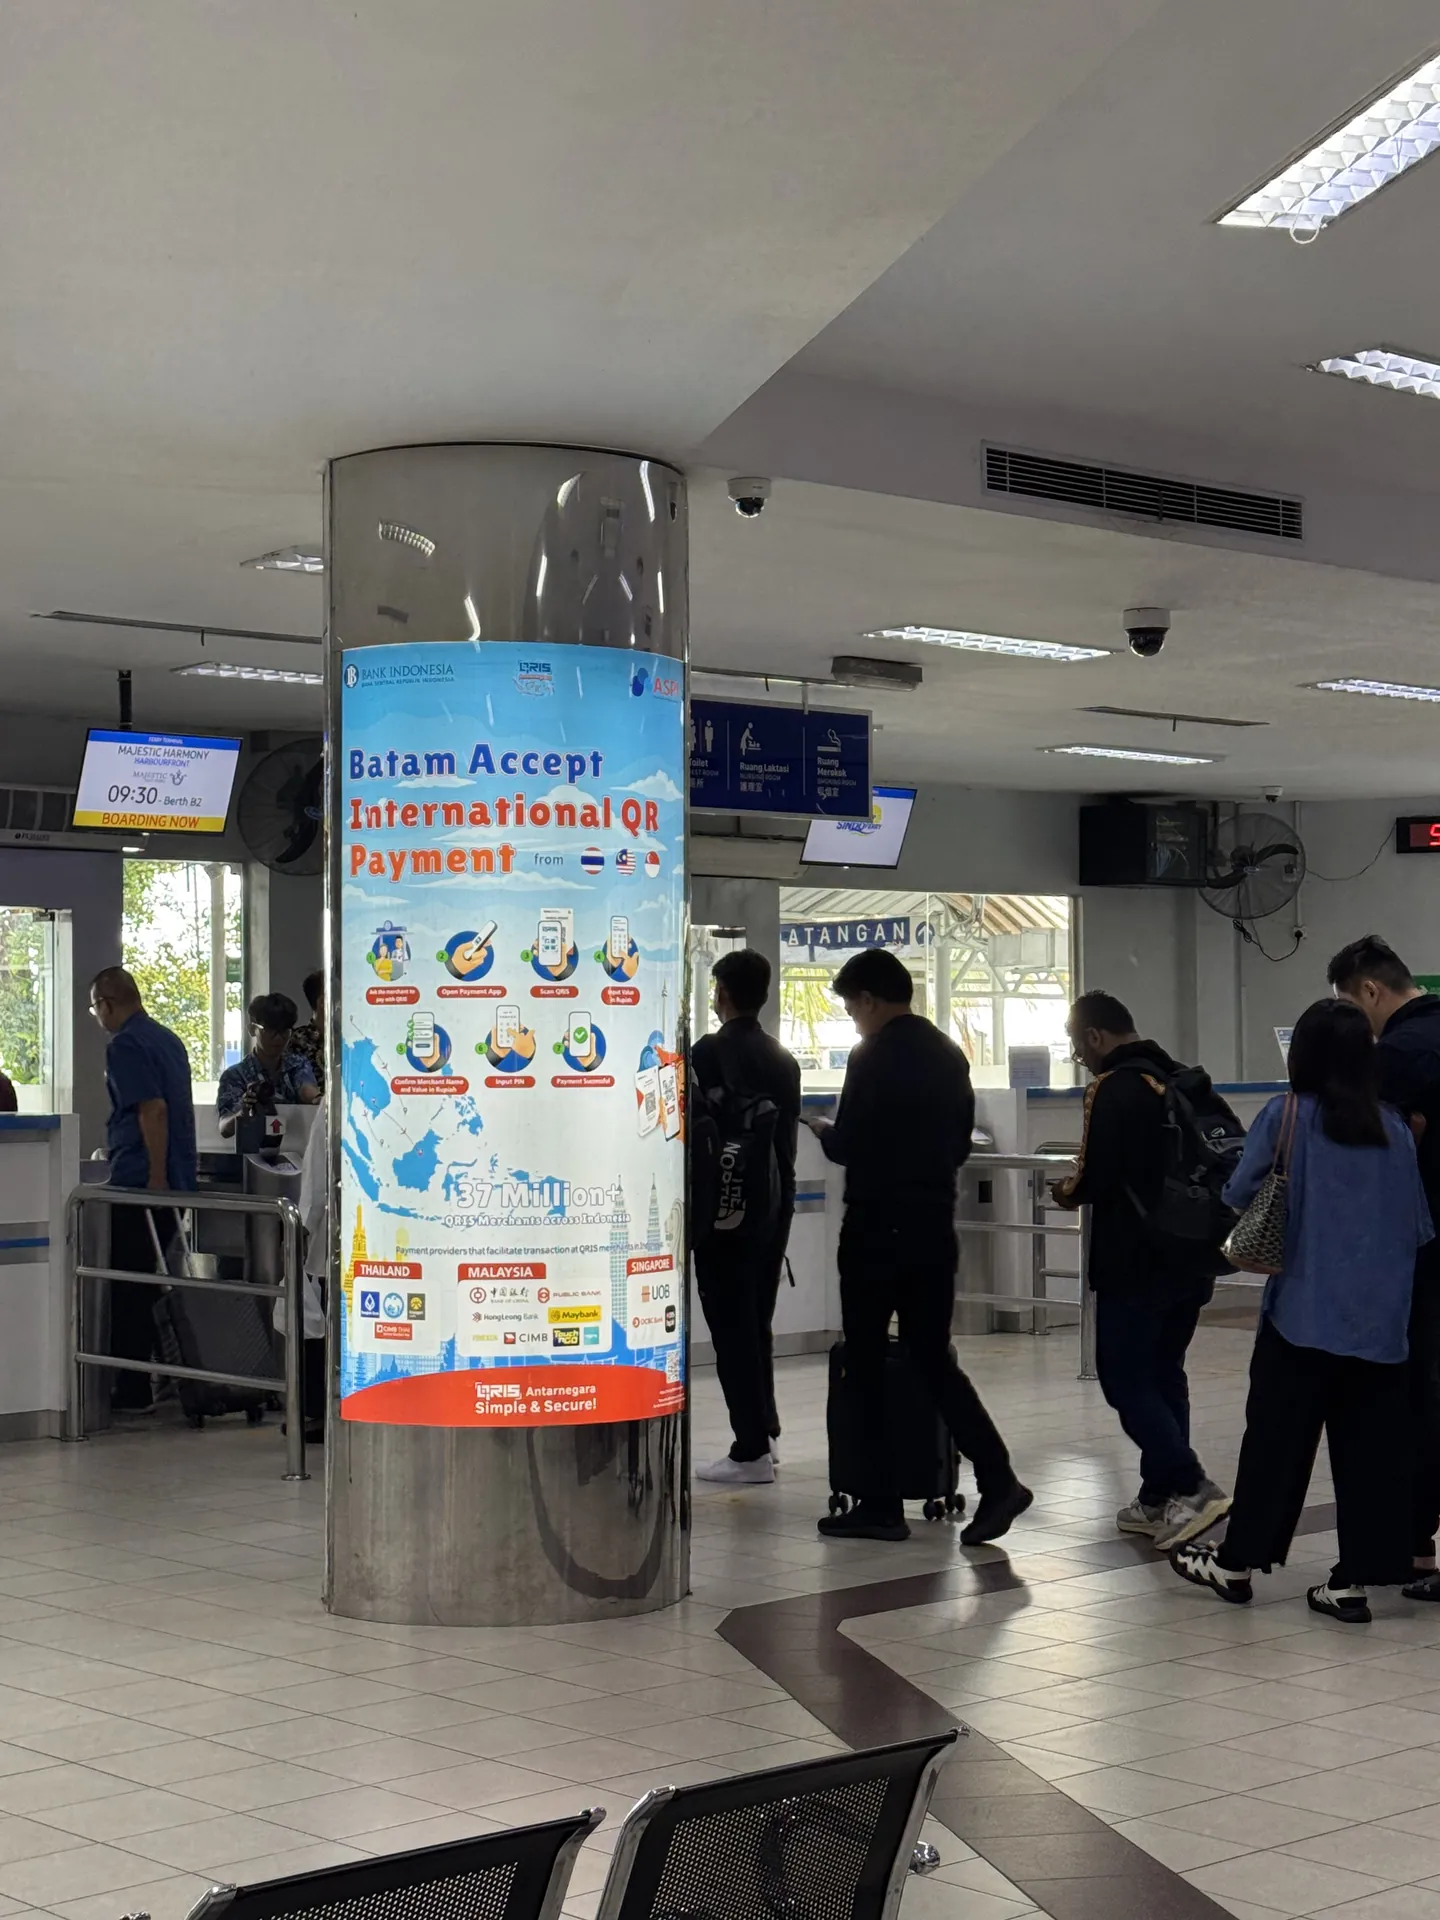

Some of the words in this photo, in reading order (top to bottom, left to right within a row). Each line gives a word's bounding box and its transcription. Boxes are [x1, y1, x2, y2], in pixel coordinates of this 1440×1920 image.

[362, 667, 386, 680] BANK
[390, 664, 454, 677] INDONESIA
[519, 662, 551, 673] QRIS
[653, 677, 678, 695] ASPI
[118, 745, 161, 757] MAJESTIC
[162, 747, 210, 760] HARMONY
[134, 757, 190, 767] HARBOURFRONT
[349, 748, 456, 780] Batam
[467, 742, 604, 785] Accept
[740, 761, 763, 773] Ruang
[764, 763, 790, 773] Laktasi
[817, 756, 839, 768] Ruang
[133, 770, 168, 780] MAJESTIC
[817, 767, 847, 778] Merokok
[108, 784, 158, 805] 09:30
[163, 796, 188, 806] Berth
[190, 797, 203, 807] B2
[101, 812, 167, 828] BOARDING
[169, 816, 201, 829] NOW
[349, 792, 612, 830] International
[620, 797, 659, 838] QR
[349, 843, 517, 882] Payment
[534, 853, 564, 866] from
[495, 1078, 513, 1086] Input
[457, 1182, 494, 1209] 37
[500, 1181, 621, 1209] Million+
[444, 1214, 476, 1227] QRIS
[477, 1213, 542, 1227] Merchants
[543, 1214, 580, 1226] across
[581, 1212, 631, 1225] Indonesia
[396, 1246, 428, 1256] Payment
[429, 1246, 468, 1256] providers
[469, 1246, 486, 1255] that
[486, 1246, 523, 1255] facilitate
[523, 1245, 570, 1255] transaction
[571, 1246, 579, 1254] at
[579, 1244, 598, 1254] QRIS
[360, 1264, 410, 1277] THAILAND
[468, 1266, 534, 1278] MALAYSIA
[631, 1258, 670, 1273] SINGAPORE
[652, 1284, 670, 1300] UOB
[523, 1312, 538, 1320] Bank
[562, 1309, 599, 1320] Maybank
[519, 1332, 549, 1343] CIMB
[554, 1329, 579, 1338] Touch
[475, 1382, 522, 1400] QRIS
[526, 1385, 596, 1397] Antarnegara
[475, 1400, 527, 1416] Simple
[530, 1400, 540, 1413] &
[544, 1397, 597, 1413] Secure!
